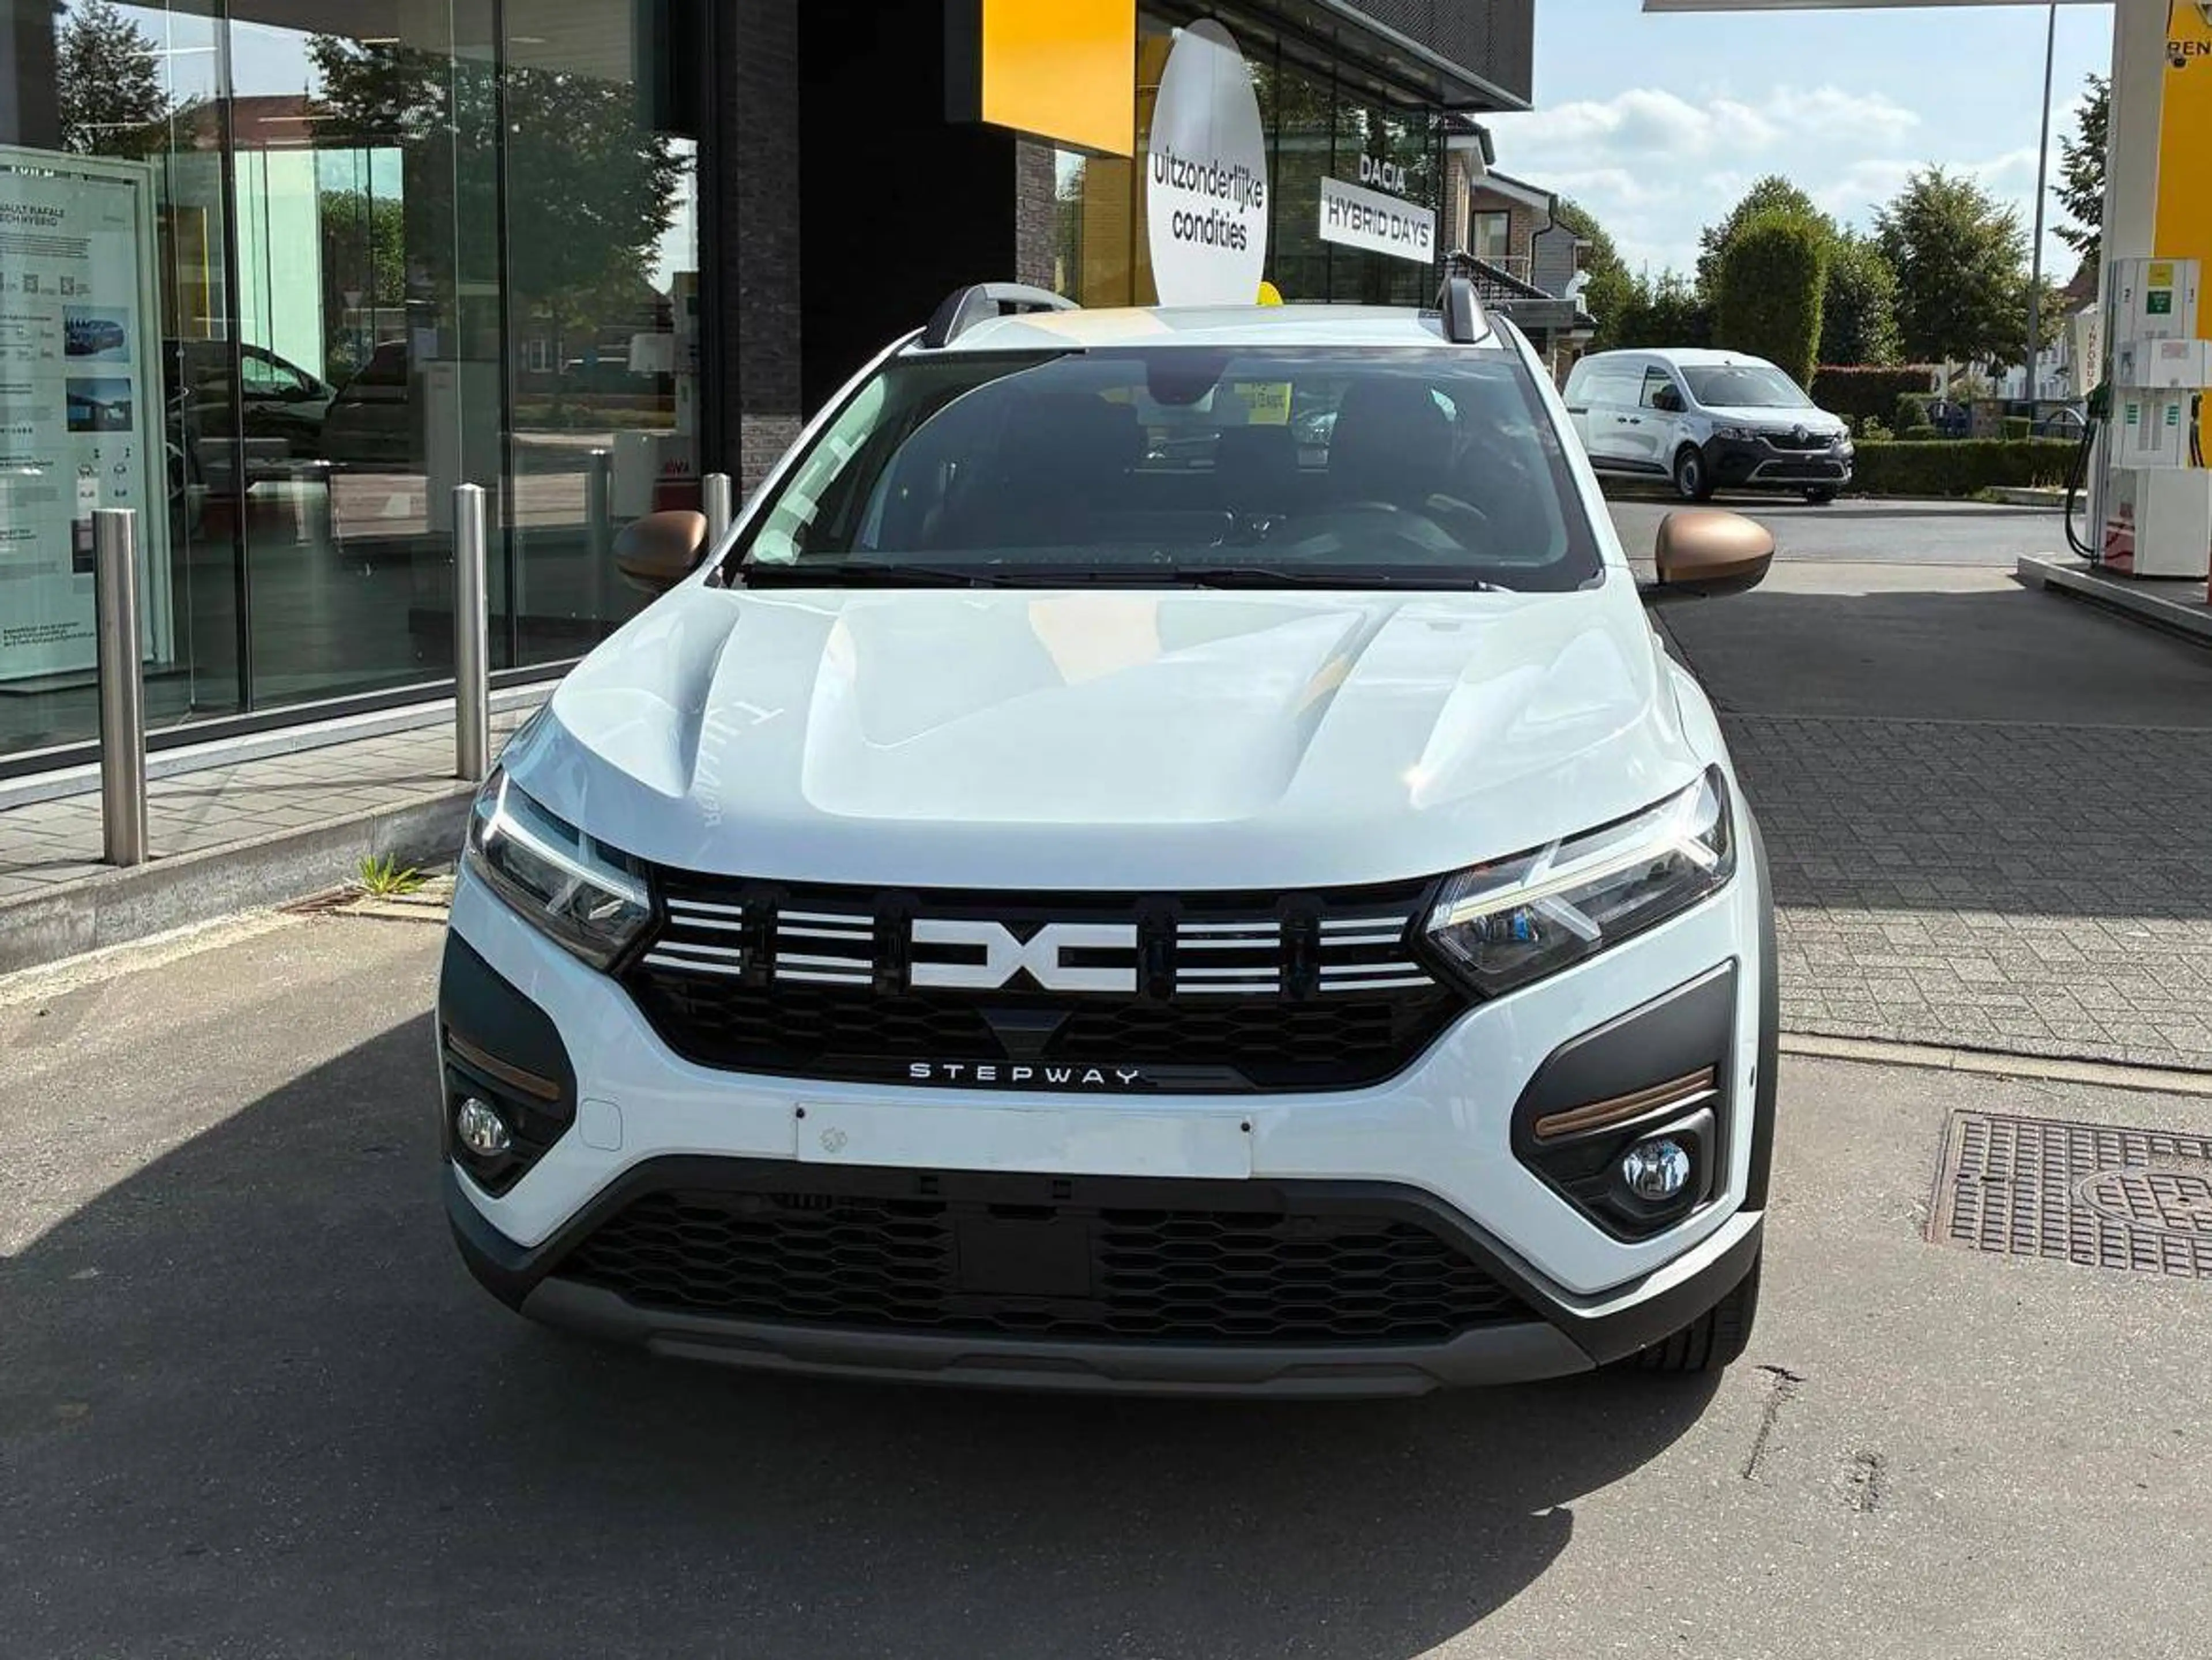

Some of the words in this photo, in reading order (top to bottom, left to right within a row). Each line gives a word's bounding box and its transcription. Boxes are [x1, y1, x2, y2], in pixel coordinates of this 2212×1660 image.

[1155, 145, 1263, 214] uitzonderlijke
[1359, 152, 1406, 194] DACIA
[1172, 207, 1248, 251] condities
[1328, 195, 1387, 236] HYBRID
[1391, 214, 1429, 247] DAYS
[909, 1062, 1140, 1085] STEPWAY
